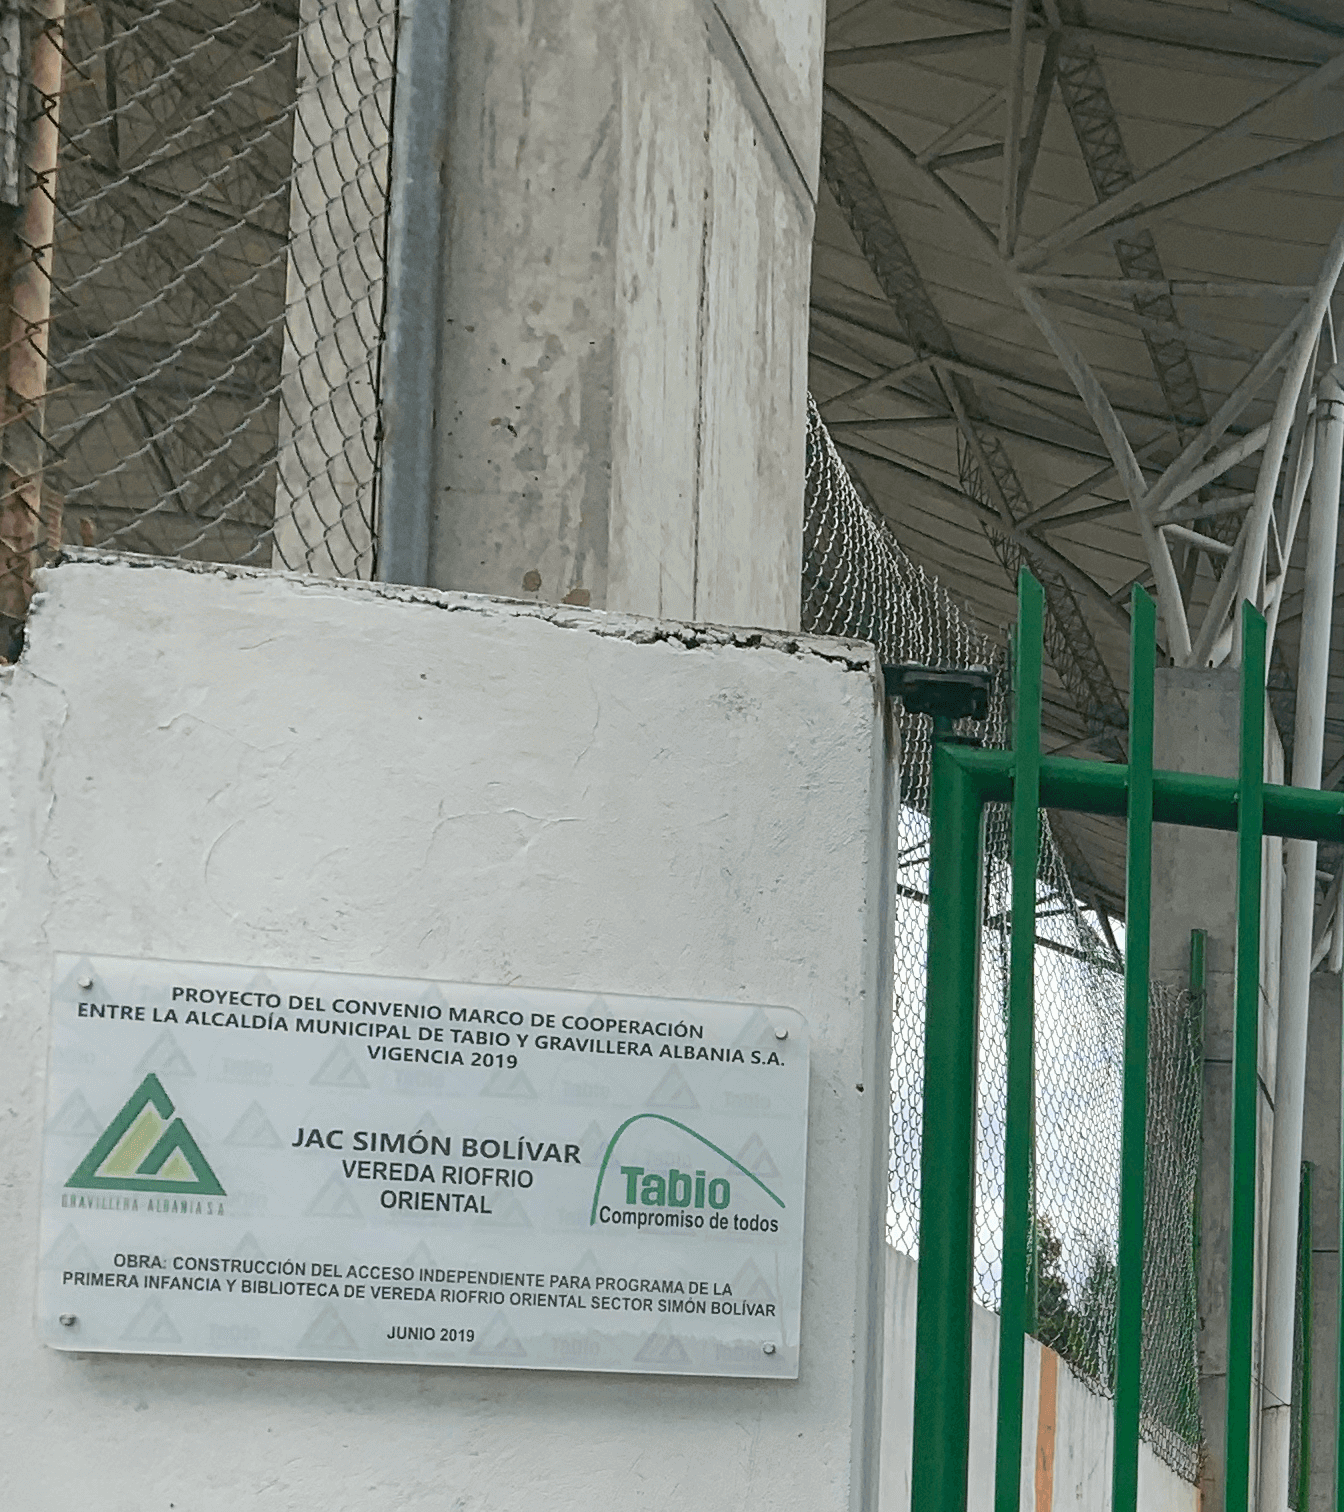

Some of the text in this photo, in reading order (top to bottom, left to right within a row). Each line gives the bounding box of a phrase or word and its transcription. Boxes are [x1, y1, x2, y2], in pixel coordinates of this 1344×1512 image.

[171, 986, 704, 1040] PROYECTO DEL CONVENIO MARCO DE COOPERACIÓN
[77, 1001, 785, 1067] ENTRE LA ALCALDÍA MUNICIPAL DE TABIO Y GRAVILLERA ALBANIA S.A.
[366, 1044, 518, 1070] VIGENCIA 2019
[291, 1127, 582, 1165] JAC SIMÓN BOLÍVAR
[341, 1159, 534, 1189] VEREDA RIOFRIO
[620, 1165, 731, 1210] Tabio
[380, 1189, 493, 1215] ORIENTAL
[599, 1205, 779, 1233] Compromiso de todos
[62, 1270, 776, 1317] PRIMERA INFANCIA Y BIBLIOTECA DE VEREDA RIOFRIO ORIENTAL SECTOR SIMÓN BOLÍVAR
[113, 1253, 733, 1297] OBRA: CONSTRUCCIÓN DEL ACCESO INDEPENDIENTE PARA PROGRAMA DE LA
[386, 1325, 475, 1343] JUNIO 2019
